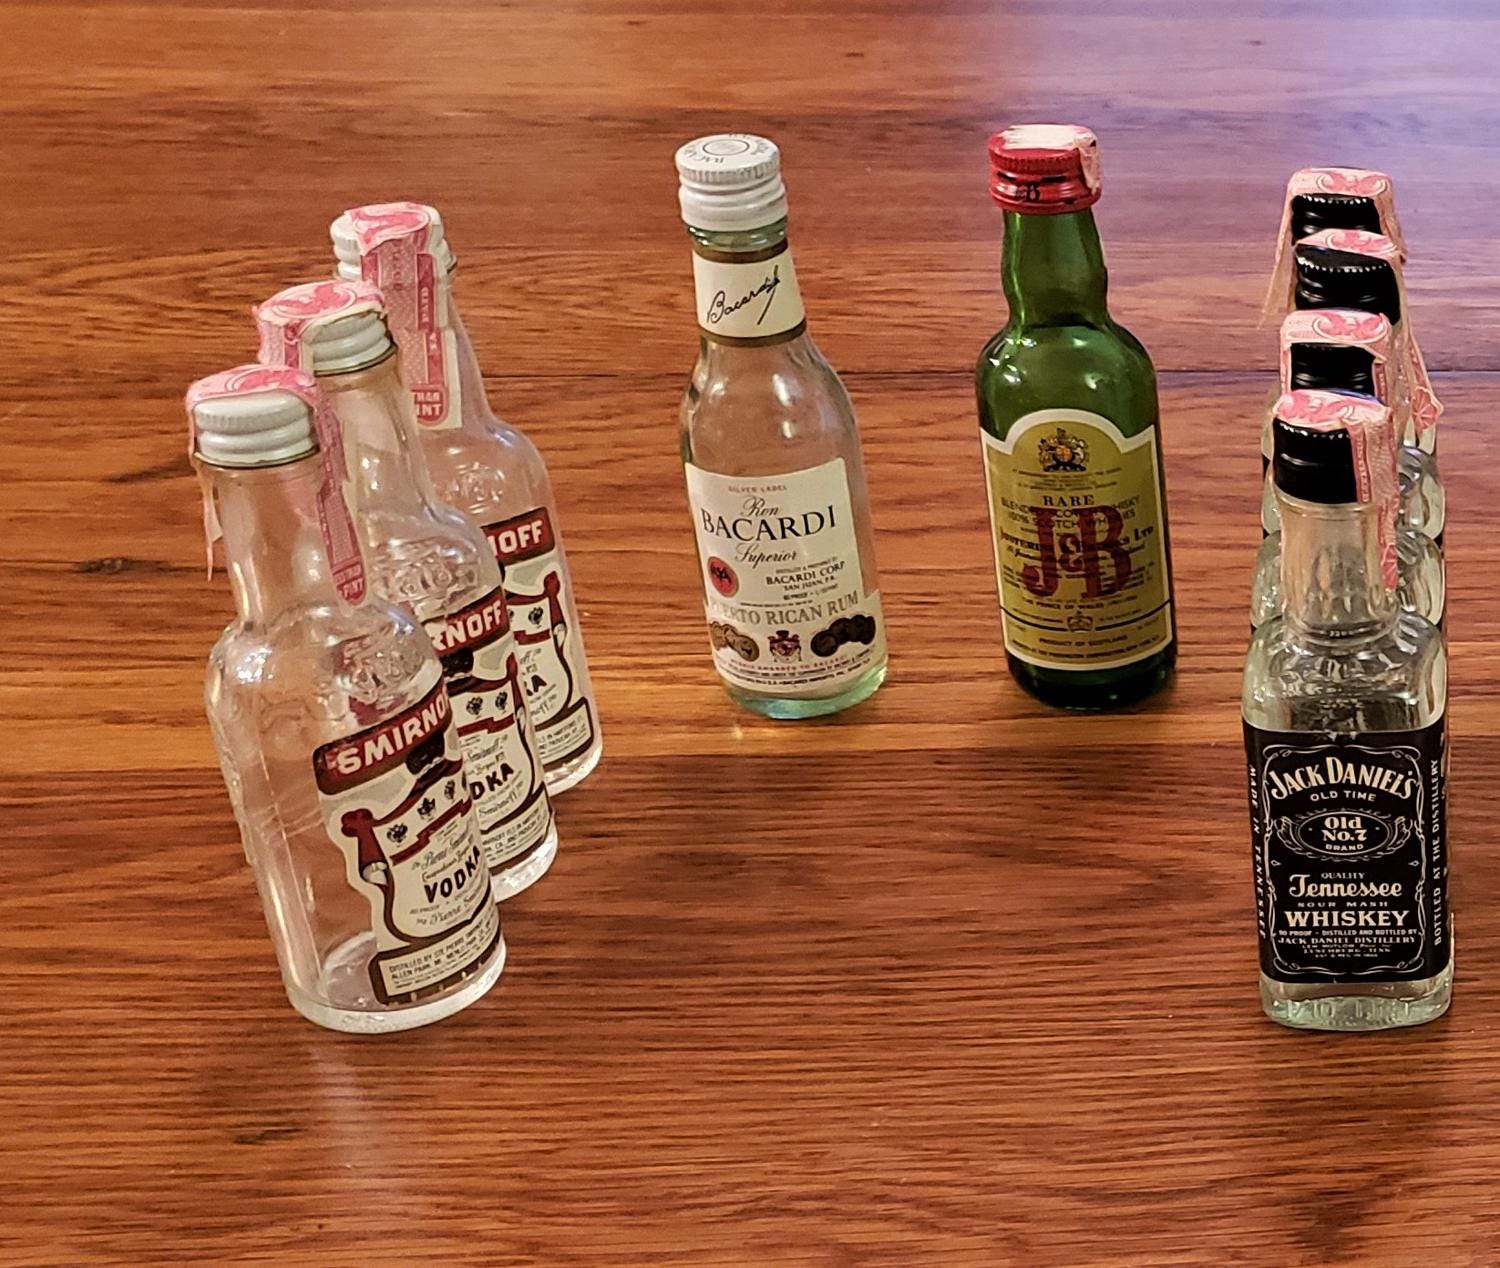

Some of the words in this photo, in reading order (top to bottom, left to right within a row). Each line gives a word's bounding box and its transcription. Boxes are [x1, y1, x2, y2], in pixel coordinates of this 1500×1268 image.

[741, 495, 779, 517] Ron
[1043, 494, 1095, 507] RARE
[701, 505, 836, 542] BACARDI
[492, 519, 546, 556] OFF
[735, 542, 797, 569] Superior
[1023, 505, 1133, 597] J&B
[766, 571, 816, 585] BACARDI
[766, 605, 822, 625] RICAN
[828, 591, 859, 616] RUM
[336, 689, 448, 774] SMIRNO
[1249, 764, 1258, 809] MADE
[1268, 763, 1327, 800] JACK
[1326, 756, 1417, 800] DANIEL'S
[1310, 790, 1338, 801] OLD
[1343, 790, 1377, 802] TIME
[1430, 759, 1440, 833] DISTILLERY
[1321, 829, 1367, 842] No.7
[1324, 816, 1362, 830] Old
[1325, 843, 1364, 851] BRAND
[1432, 836, 1440, 861] THE
[424, 846, 480, 904] VODKA
[1321, 872, 1366, 880] QUALITY
[1433, 866, 1440, 880] AT
[1255, 845, 1267, 940] TENNESSEE
[1289, 874, 1402, 898] Tennessee
[1284, 910, 1410, 927] WHISKEY
[1433, 887, 1442, 946] BOTTLED
[1278, 937, 1306, 945] JACK
[1311, 937, 1349, 945] DANIEL
[1354, 936, 1416, 944] DISTILLERY
